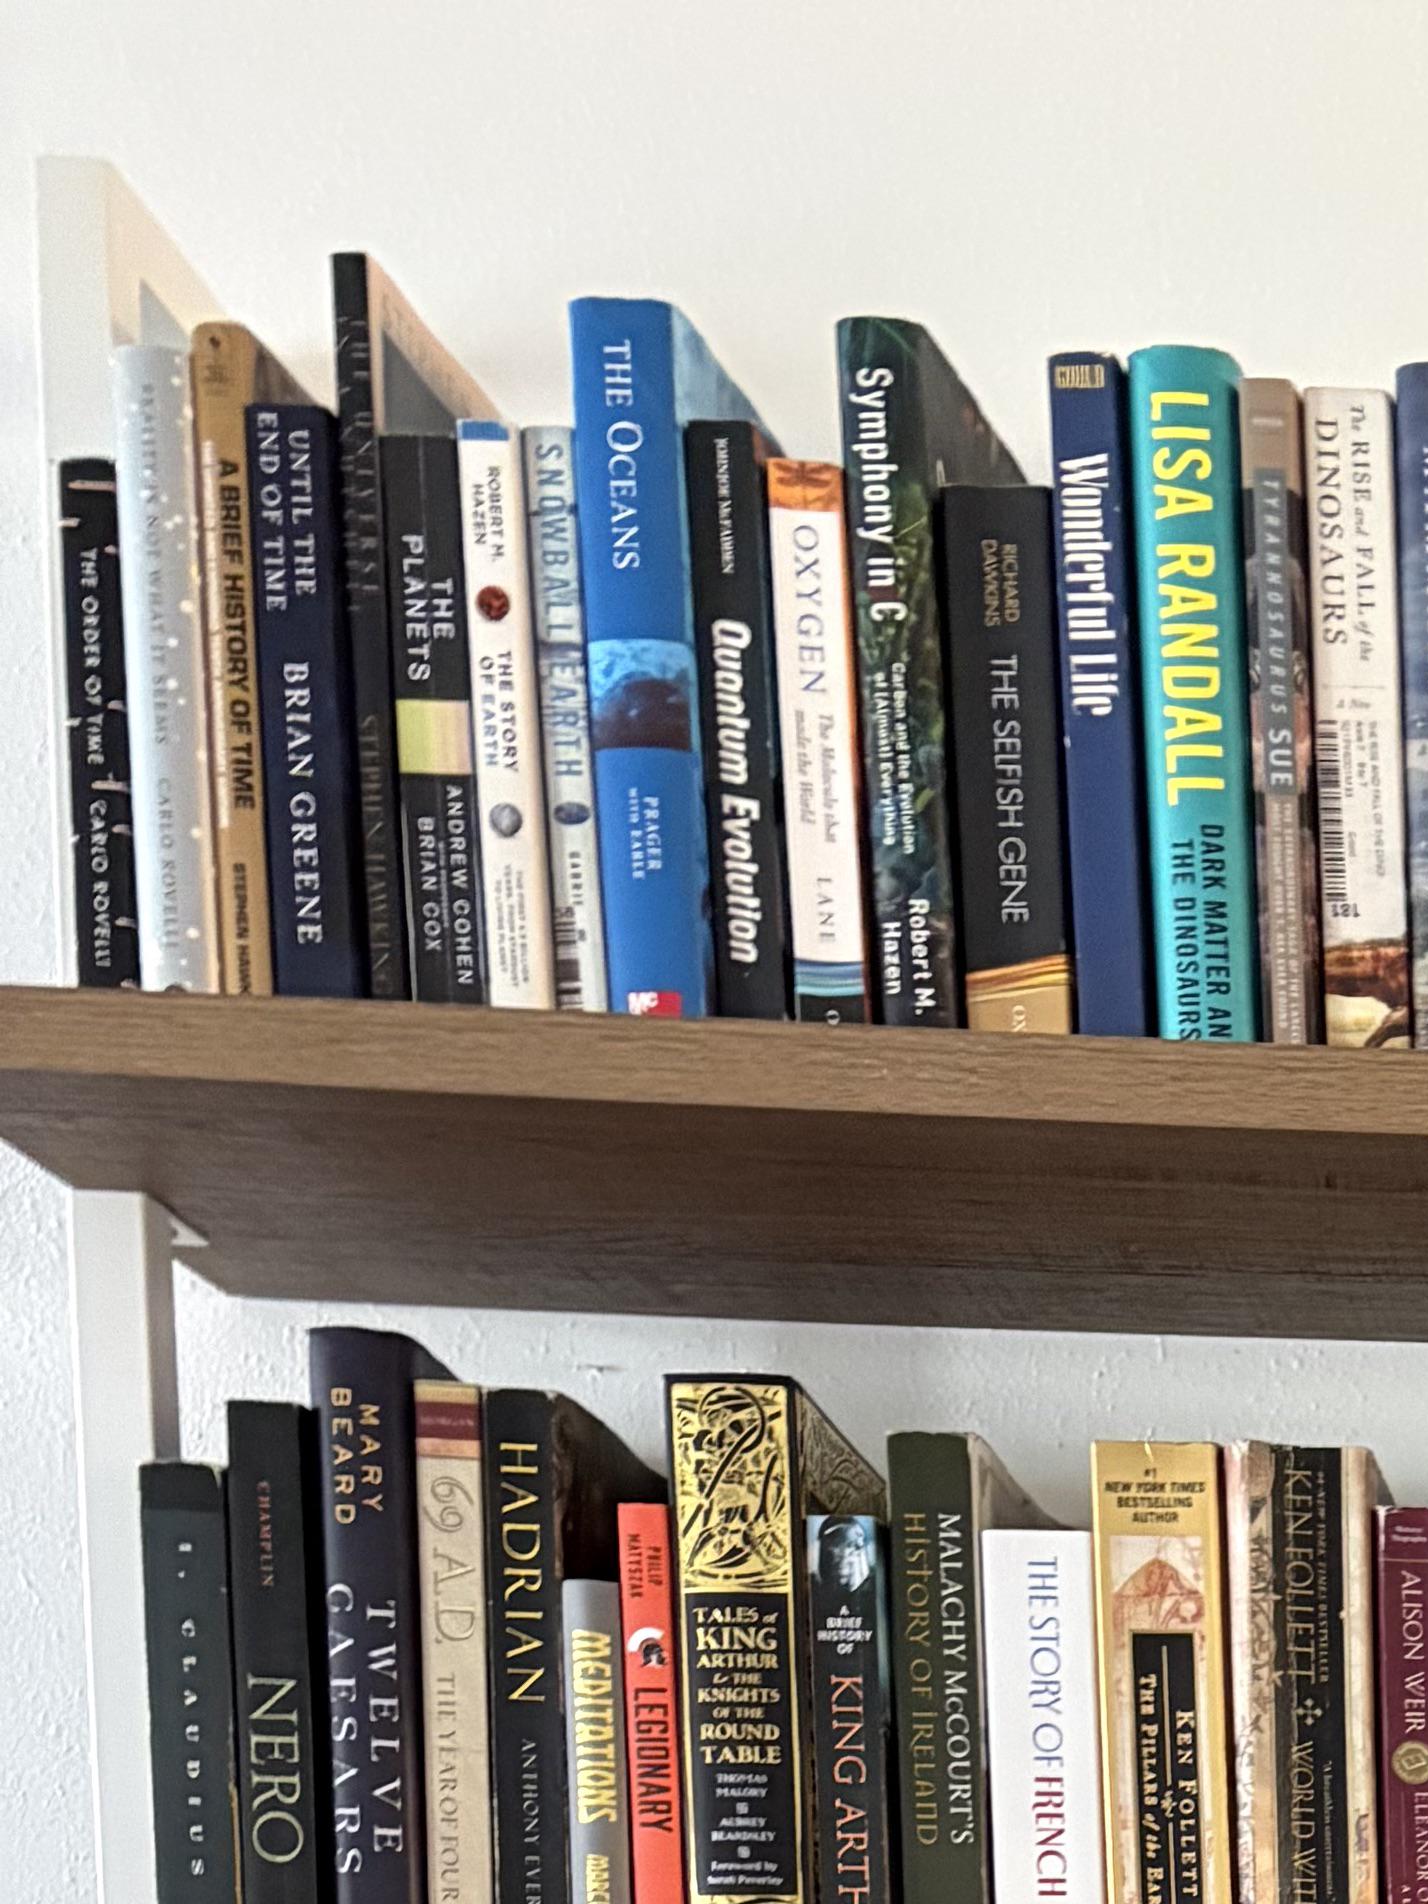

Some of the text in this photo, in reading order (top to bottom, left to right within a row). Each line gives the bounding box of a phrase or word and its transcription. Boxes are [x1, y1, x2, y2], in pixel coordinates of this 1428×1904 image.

[603, 340, 642, 570] THE OCEANS
[793, 524, 825, 694] OXYGEN
[1059, 454, 1120, 717] Wonderful Life
[1149, 390, 1225, 806] LISA RANDALL
[283, 663, 322, 945] BRIAN GREENE
[712, 621, 759, 962] Quantum Evolution
[331, 1387, 355, 1526] BEARD
[359, 1404, 383, 1512] MARY
[498, 1440, 545, 1703] HADRIAN
[697, 1627, 777, 1651] KING
[248, 1675, 304, 1862] NERO
[634, 1686, 675, 1834] LEGIONARY
[700, 1722, 779, 1741] ROUND
[700, 1744, 782, 1764] TABLE
